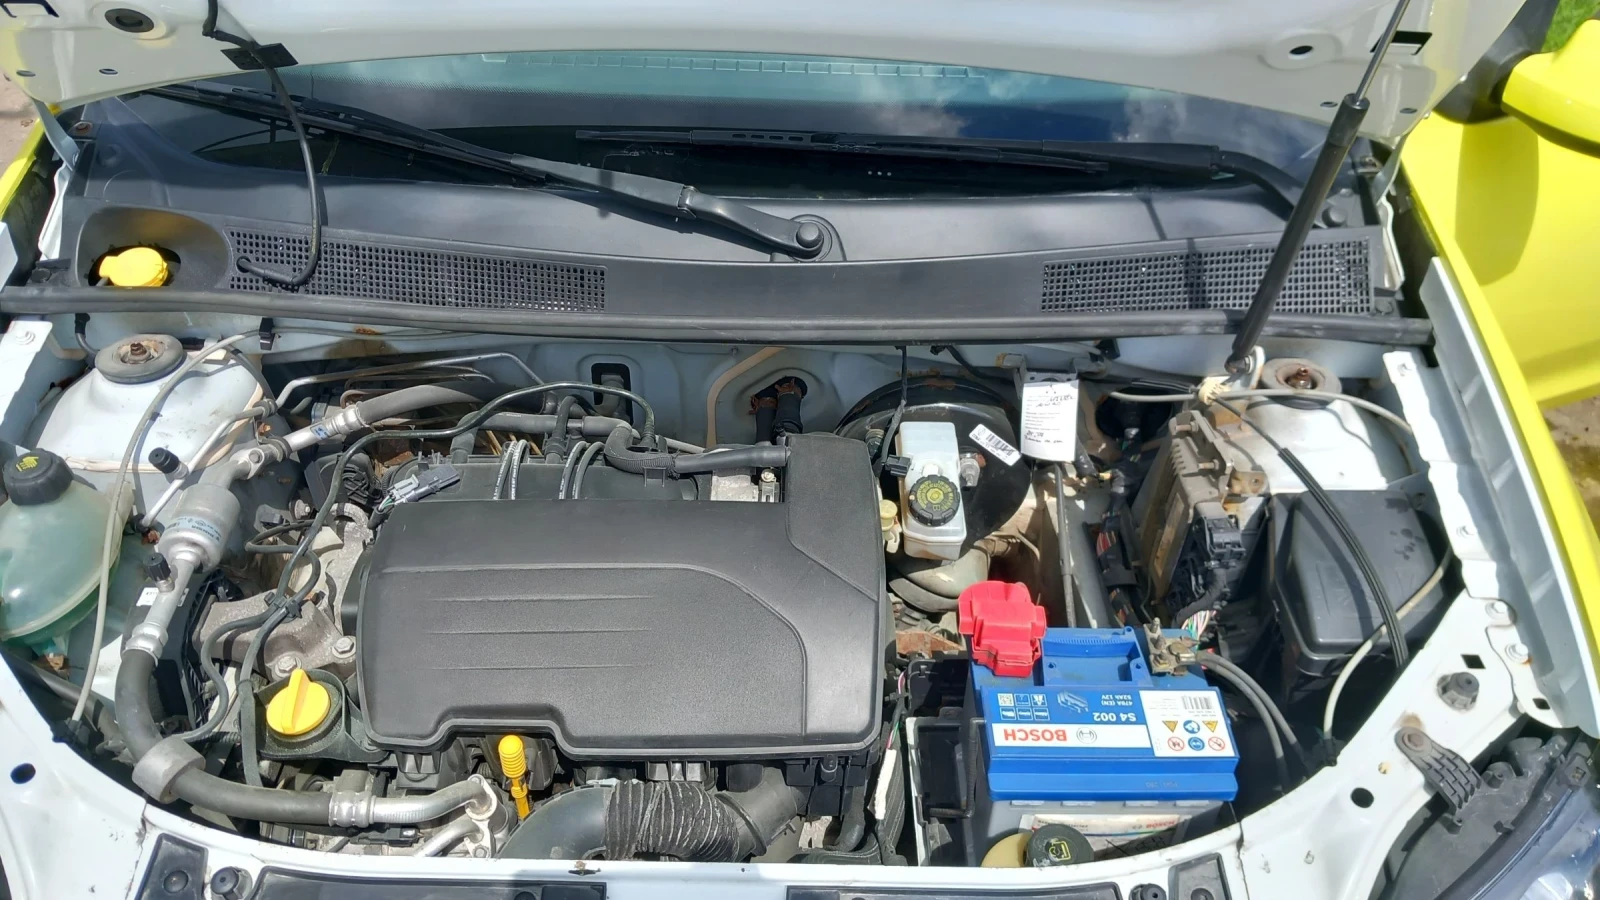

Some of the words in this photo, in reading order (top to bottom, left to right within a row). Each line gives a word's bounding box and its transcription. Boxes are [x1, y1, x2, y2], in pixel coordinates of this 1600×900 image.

[1092, 712, 1117, 722] 002
[1119, 712, 1137, 722] S4
[1003, 728, 1068, 741] BOSCH
